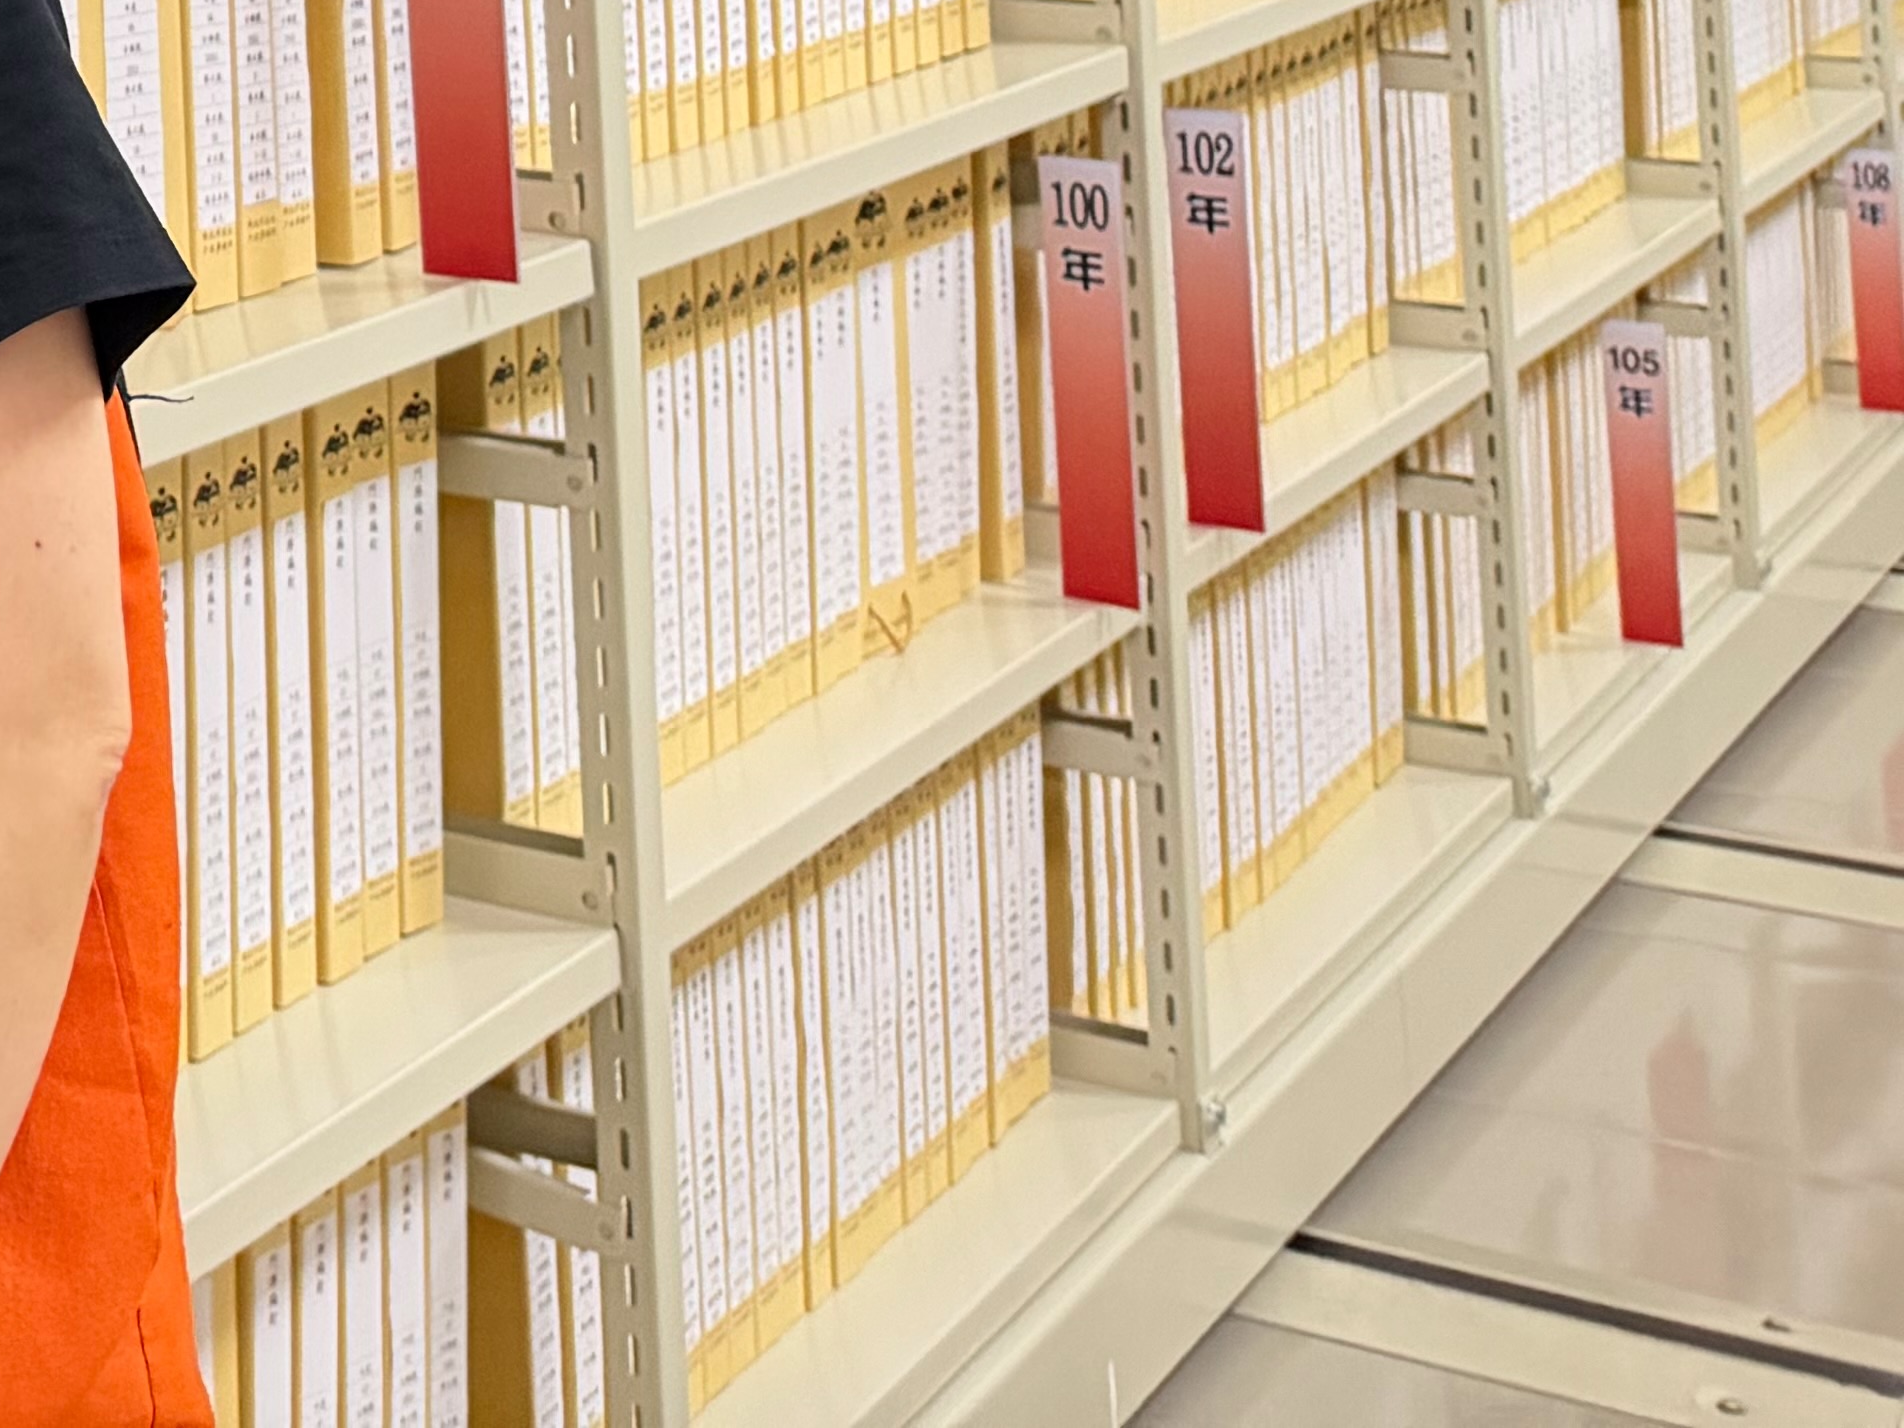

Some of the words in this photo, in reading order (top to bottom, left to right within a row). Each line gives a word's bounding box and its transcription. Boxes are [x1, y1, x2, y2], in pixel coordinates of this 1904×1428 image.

[1176, 131, 1235, 177] 102
[1851, 160, 1891, 191] 108
[1050, 181, 1109, 231] 100
[1187, 193, 1230, 235] 年
[1857, 200, 1887, 228] 年
[1061, 248, 1105, 291] 年
[1609, 347, 1660, 377] 105
[1619, 386, 1654, 419] 年
